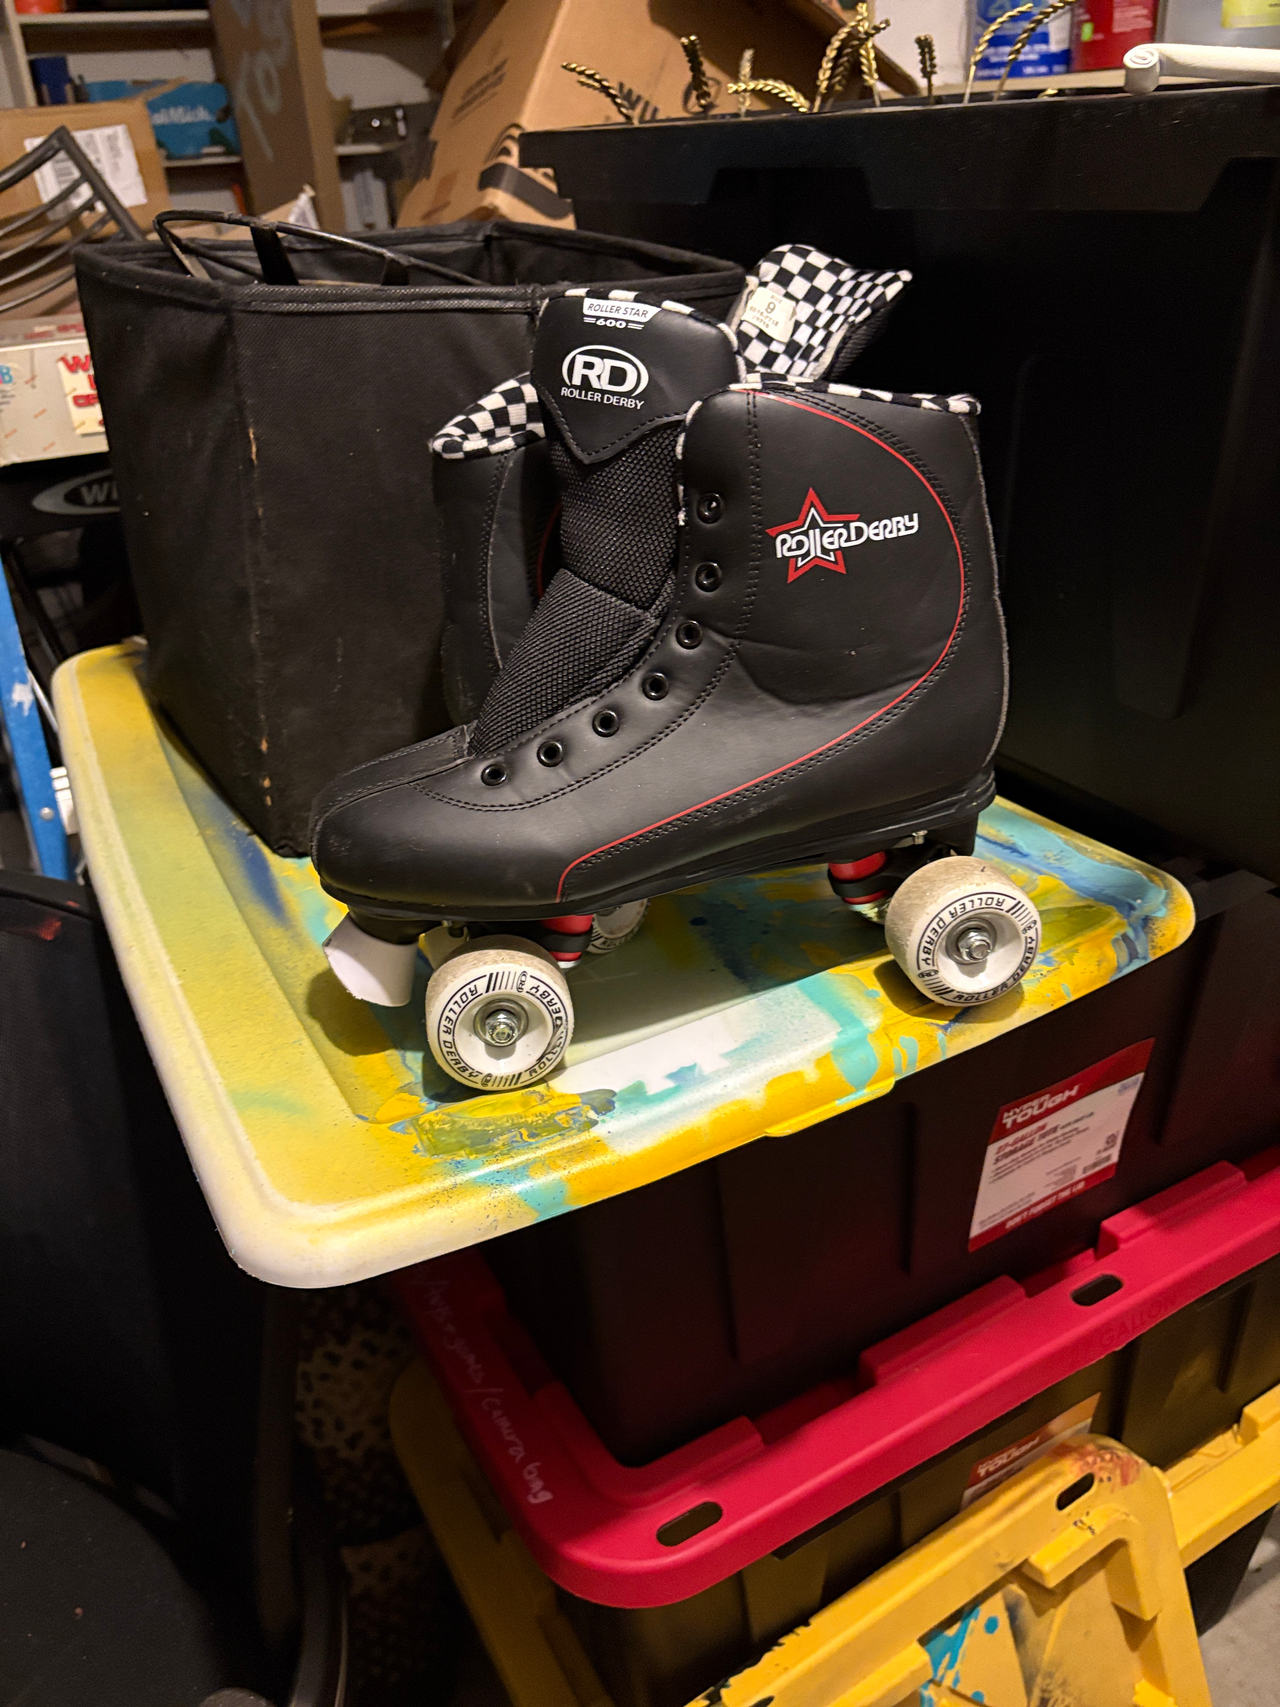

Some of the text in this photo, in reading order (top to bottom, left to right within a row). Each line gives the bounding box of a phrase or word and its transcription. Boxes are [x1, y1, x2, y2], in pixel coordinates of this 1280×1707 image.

[587, 303, 649, 318] ROLLER STAR
[596, 318, 627, 329] 600
[571, 354, 638, 392] RD
[560, 387, 645, 410] ROLLER DERBY
[948, 896, 1006, 919] ROLLER
[921, 916, 947, 967] DERBY
[442, 984, 479, 1035] ROLLER
[442, 1040, 483, 1079] DERBY
[1002, 1085, 1080, 1129] TOUGH
